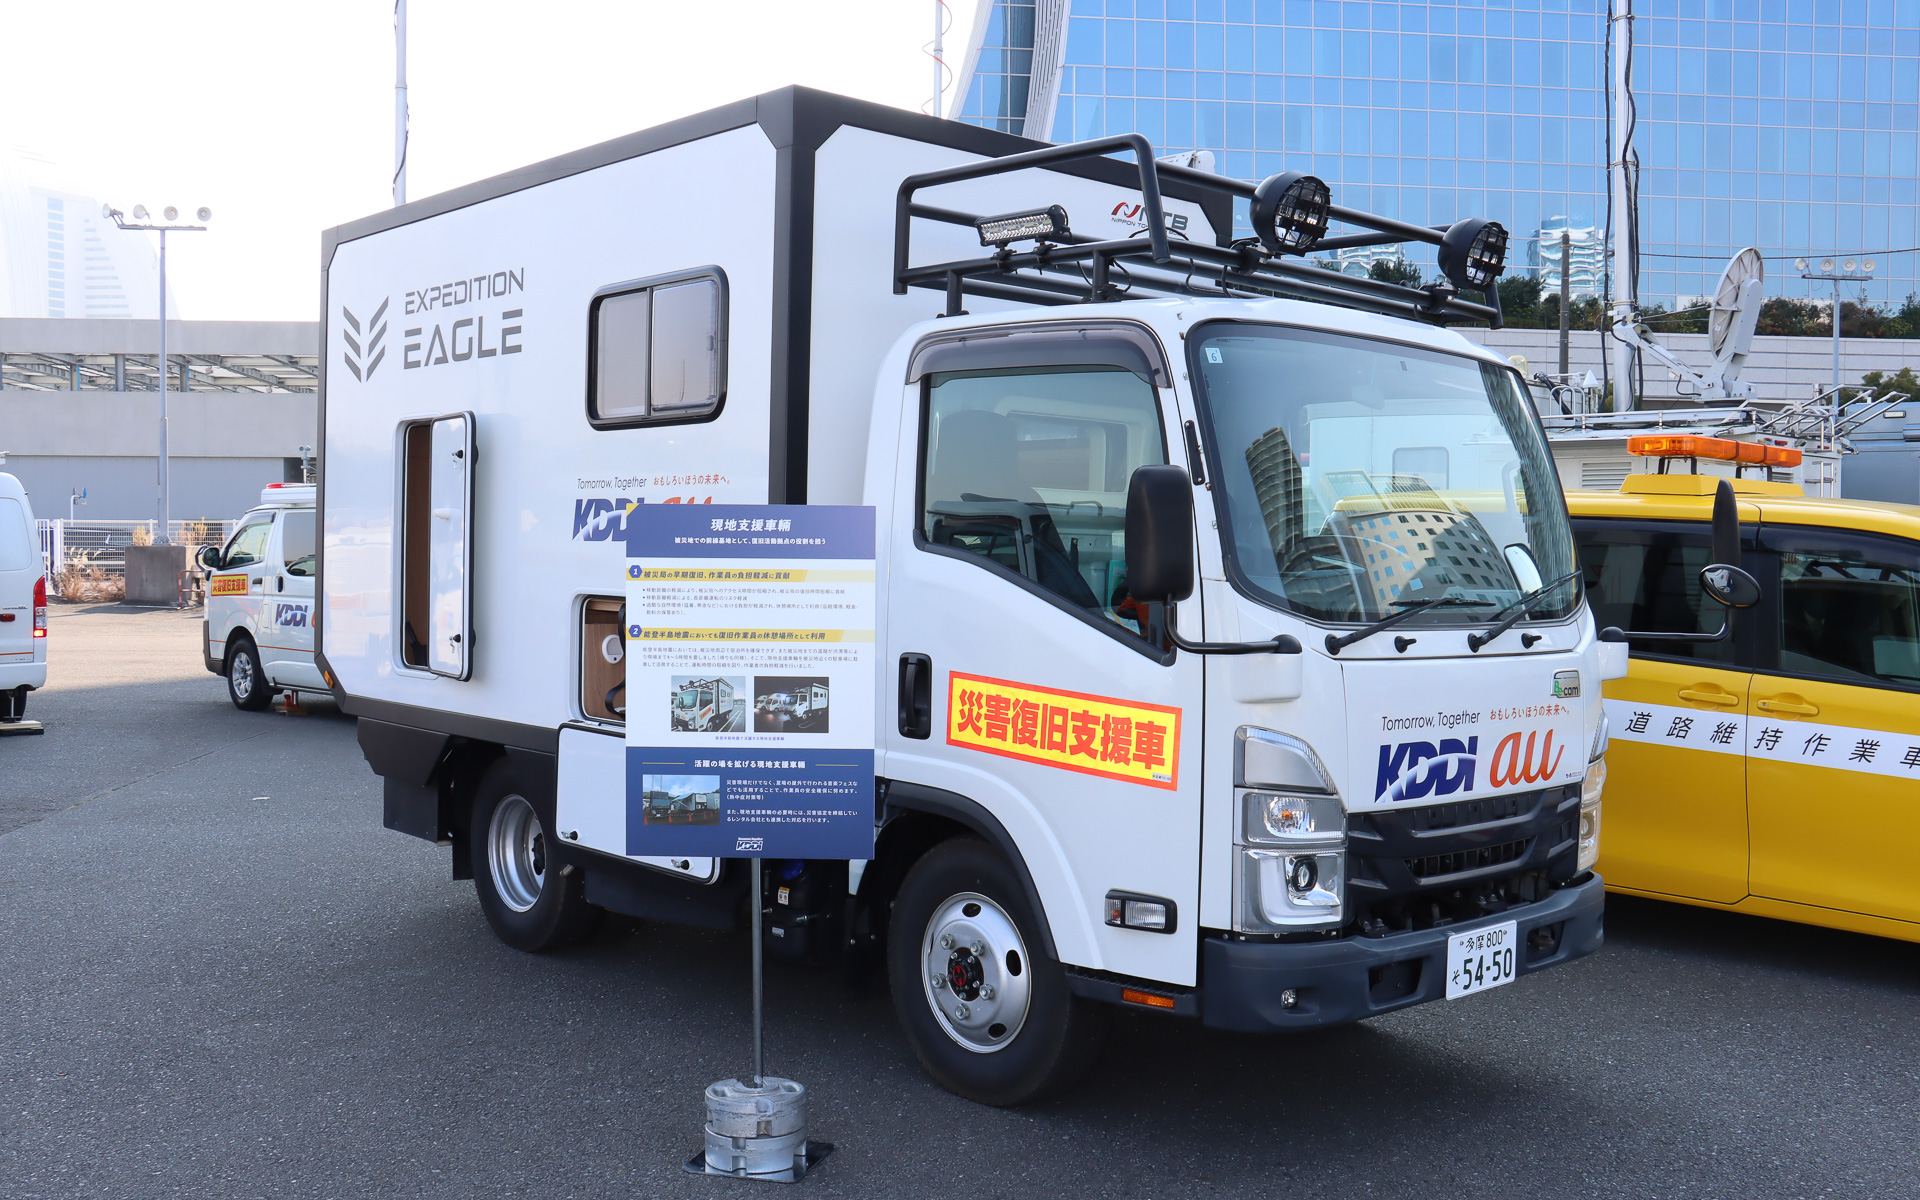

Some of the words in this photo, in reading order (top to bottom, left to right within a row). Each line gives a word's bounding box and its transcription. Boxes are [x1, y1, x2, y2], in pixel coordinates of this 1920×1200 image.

[1111, 217, 1136, 227] NIPPON
[405, 267, 524, 315] EXPEDITION
[404, 308, 523, 370] EAGLE
[1211, 352, 1218, 362] 6
[577, 478, 613, 490] Tomorrow,
[614, 476, 647, 491] Together
[653, 474, 731, 486] おもしろいほうの未来へ。
[213, 578, 246, 593] 災害復旧支援車
[275, 603, 308, 627] KDDI
[1381, 715, 1436, 731] Tomorrow,
[1437, 710, 1480, 729] Together
[1489, 704, 1570, 720] おもしろいほうの未来へ。
[957, 688, 1167, 770] 災害復旧支援車
[1624, 711, 1920, 769] 道路維持作業車
[1374, 735, 1479, 804] KDDI
[1489, 729, 1565, 788] au
[736, 841, 764, 852] KDDI
[1466, 935, 1485, 954] 多摩
[1486, 929, 1503, 948] 800
[1452, 969, 1461, 985] そ
[1463, 947, 1513, 990] 54-50
